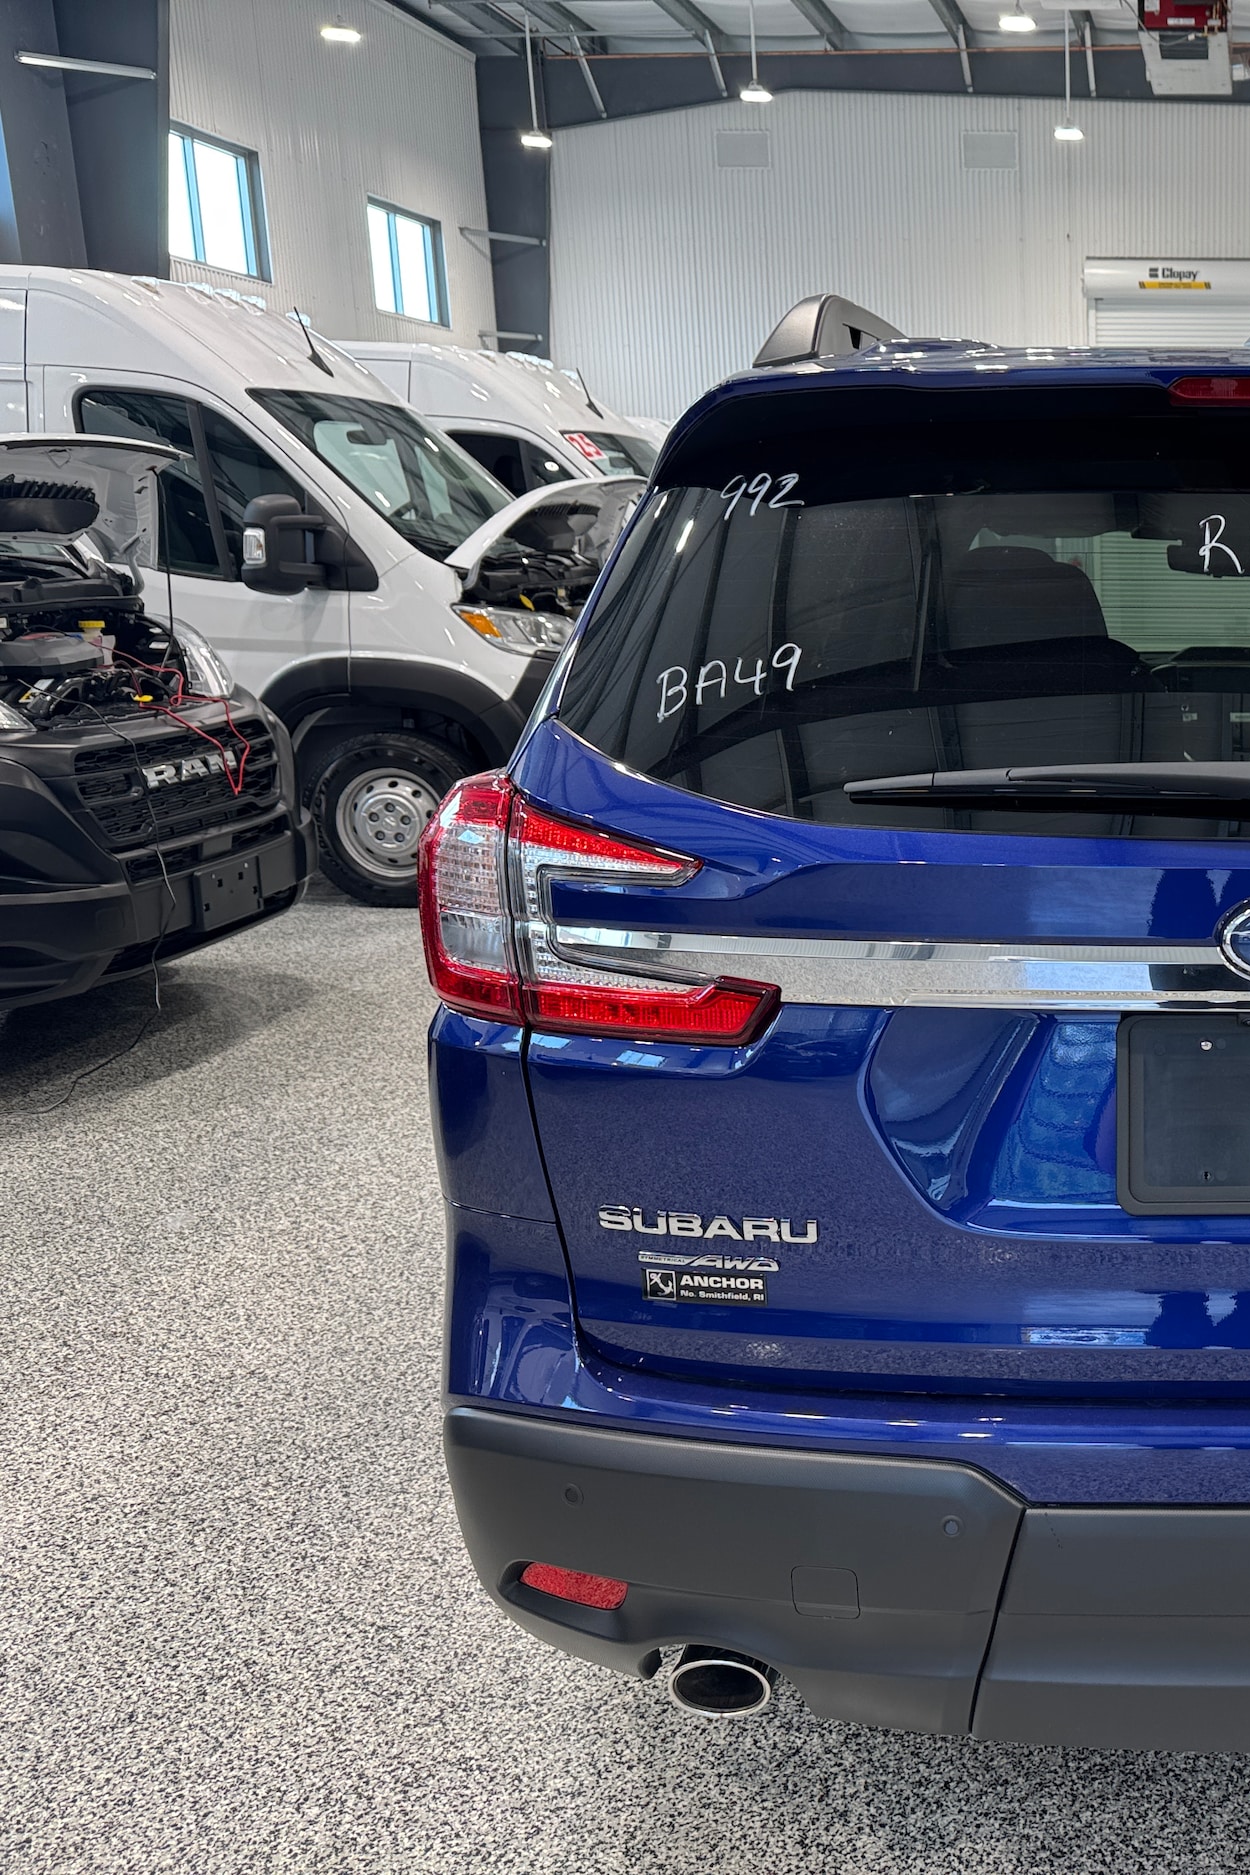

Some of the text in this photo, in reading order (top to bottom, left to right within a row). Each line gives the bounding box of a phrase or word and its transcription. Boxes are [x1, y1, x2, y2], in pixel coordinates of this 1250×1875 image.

[1161, 267, 1198, 281] Clopay
[720, 473, 805, 520] 992
[656, 643, 803, 723] BA49
[141, 750, 238, 789] RAM
[598, 1203, 818, 1244] SUBARU
[690, 1254, 779, 1272] AWD
[680, 1274, 764, 1290] ANCHOR
[680, 1290, 765, 1301] No. Smithfield, RI
